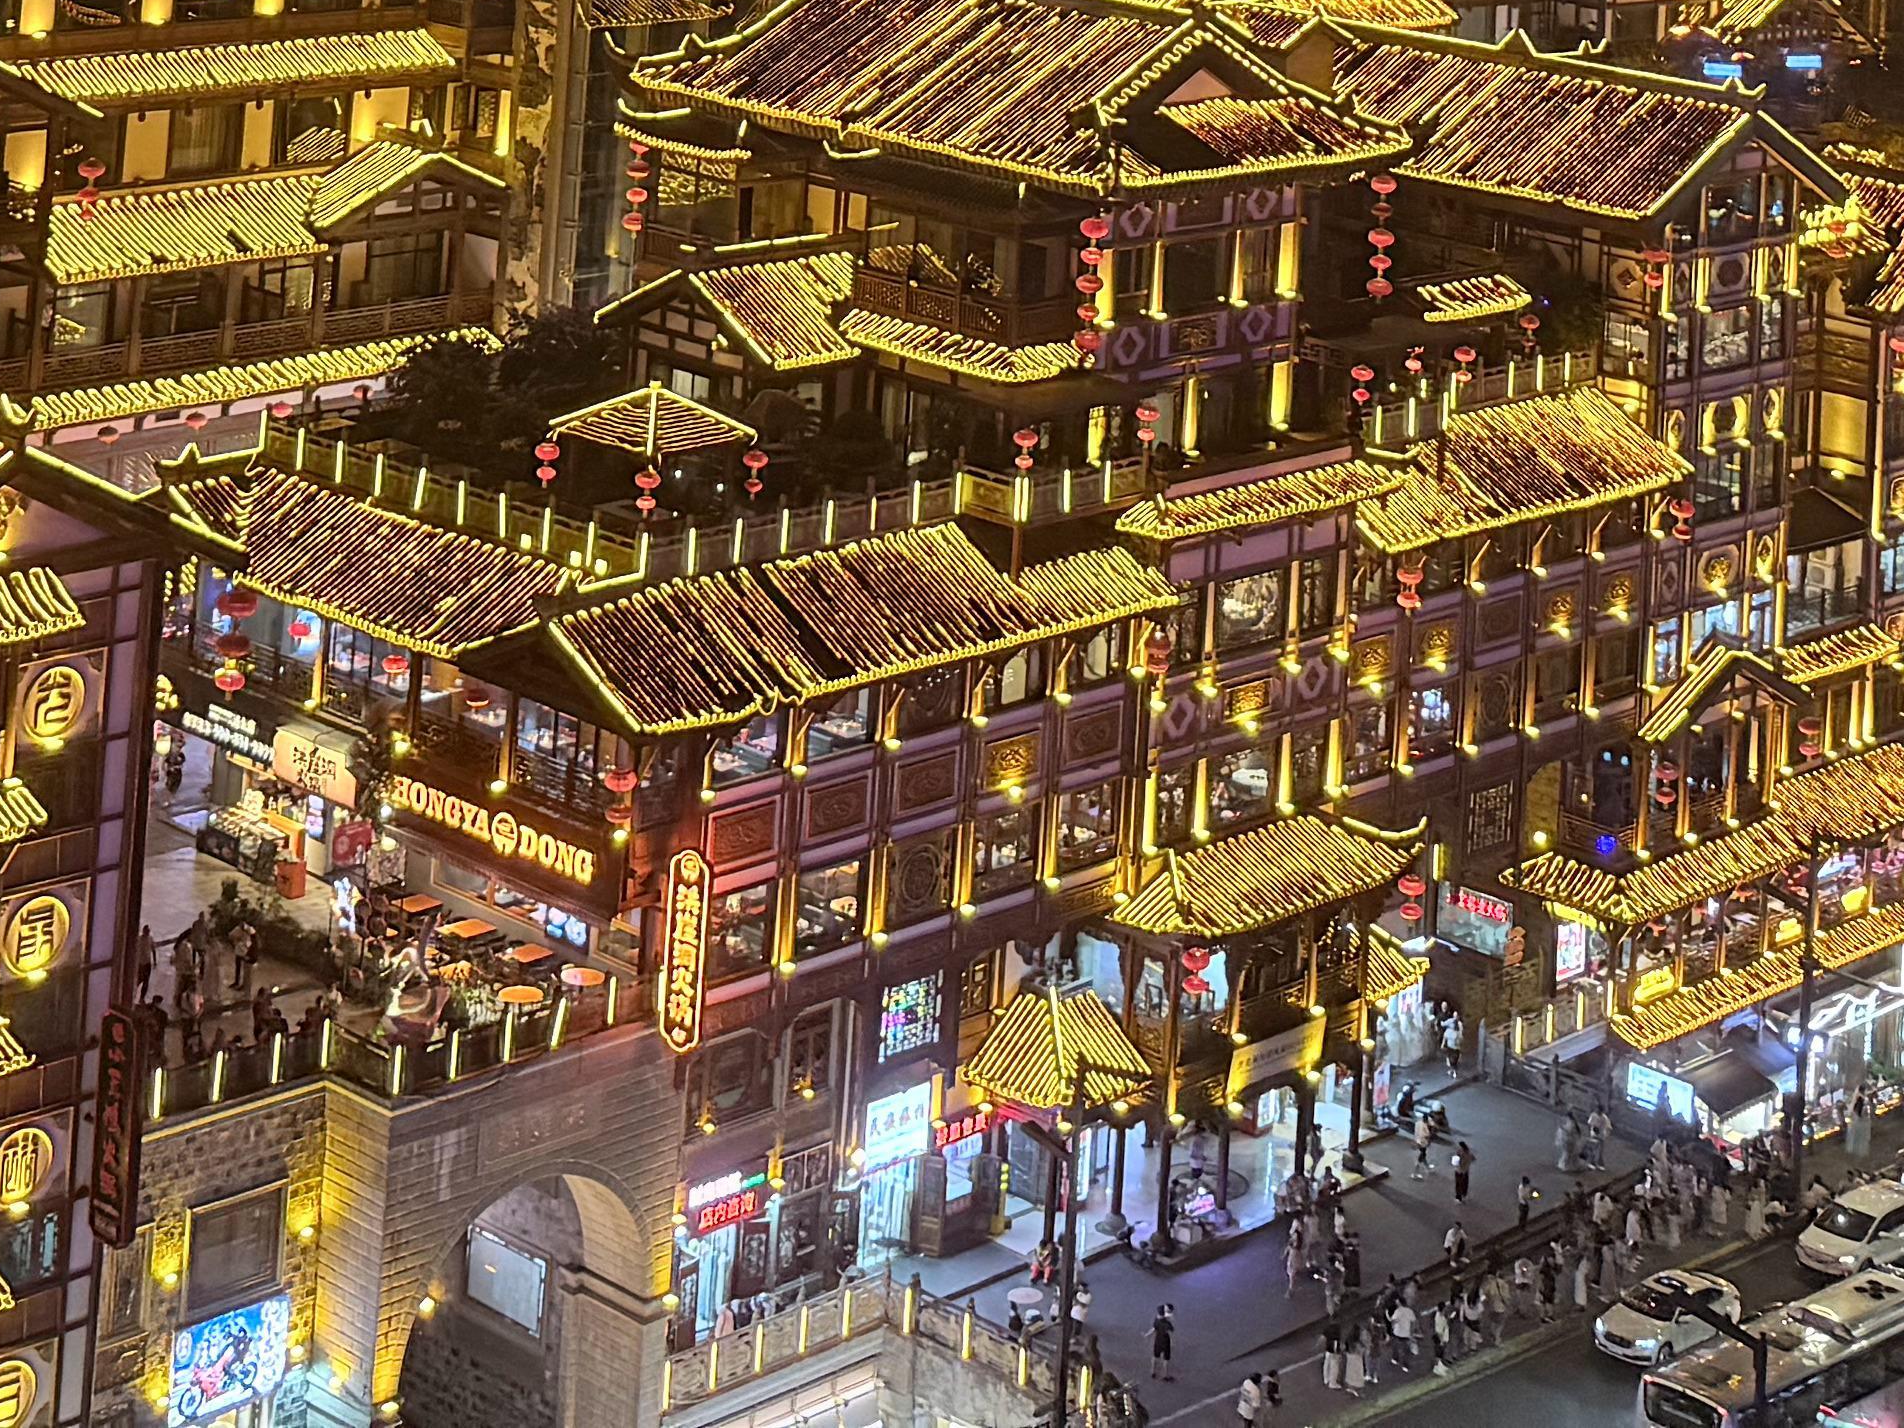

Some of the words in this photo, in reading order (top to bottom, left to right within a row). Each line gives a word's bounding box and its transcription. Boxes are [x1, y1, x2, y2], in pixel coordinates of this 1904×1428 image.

[392, 775, 491, 843] HONGYA
[519, 825, 595, 886] DONG
[667, 883, 702, 1029] 洪崖洞火锅
